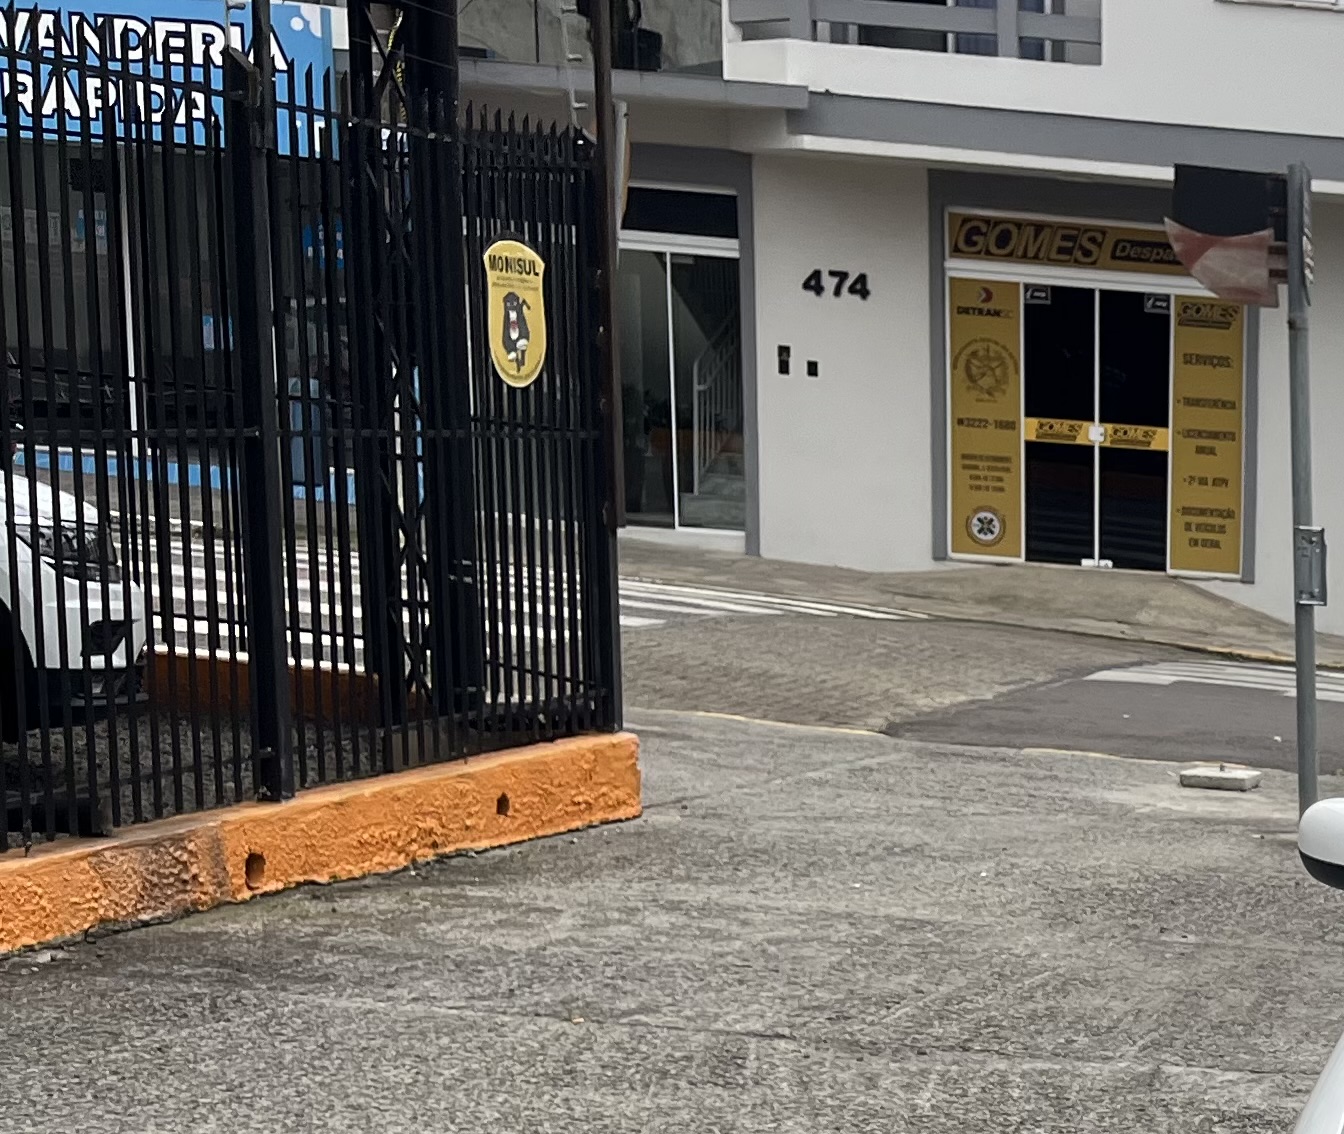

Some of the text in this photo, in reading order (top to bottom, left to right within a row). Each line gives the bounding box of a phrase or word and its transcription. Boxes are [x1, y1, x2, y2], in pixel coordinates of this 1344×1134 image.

[956, 218, 1175, 265] GOMES Despa
[488, 254, 540, 277] MONISUL
[802, 268, 871, 301] 474
[1181, 303, 1240, 322] GOMES
